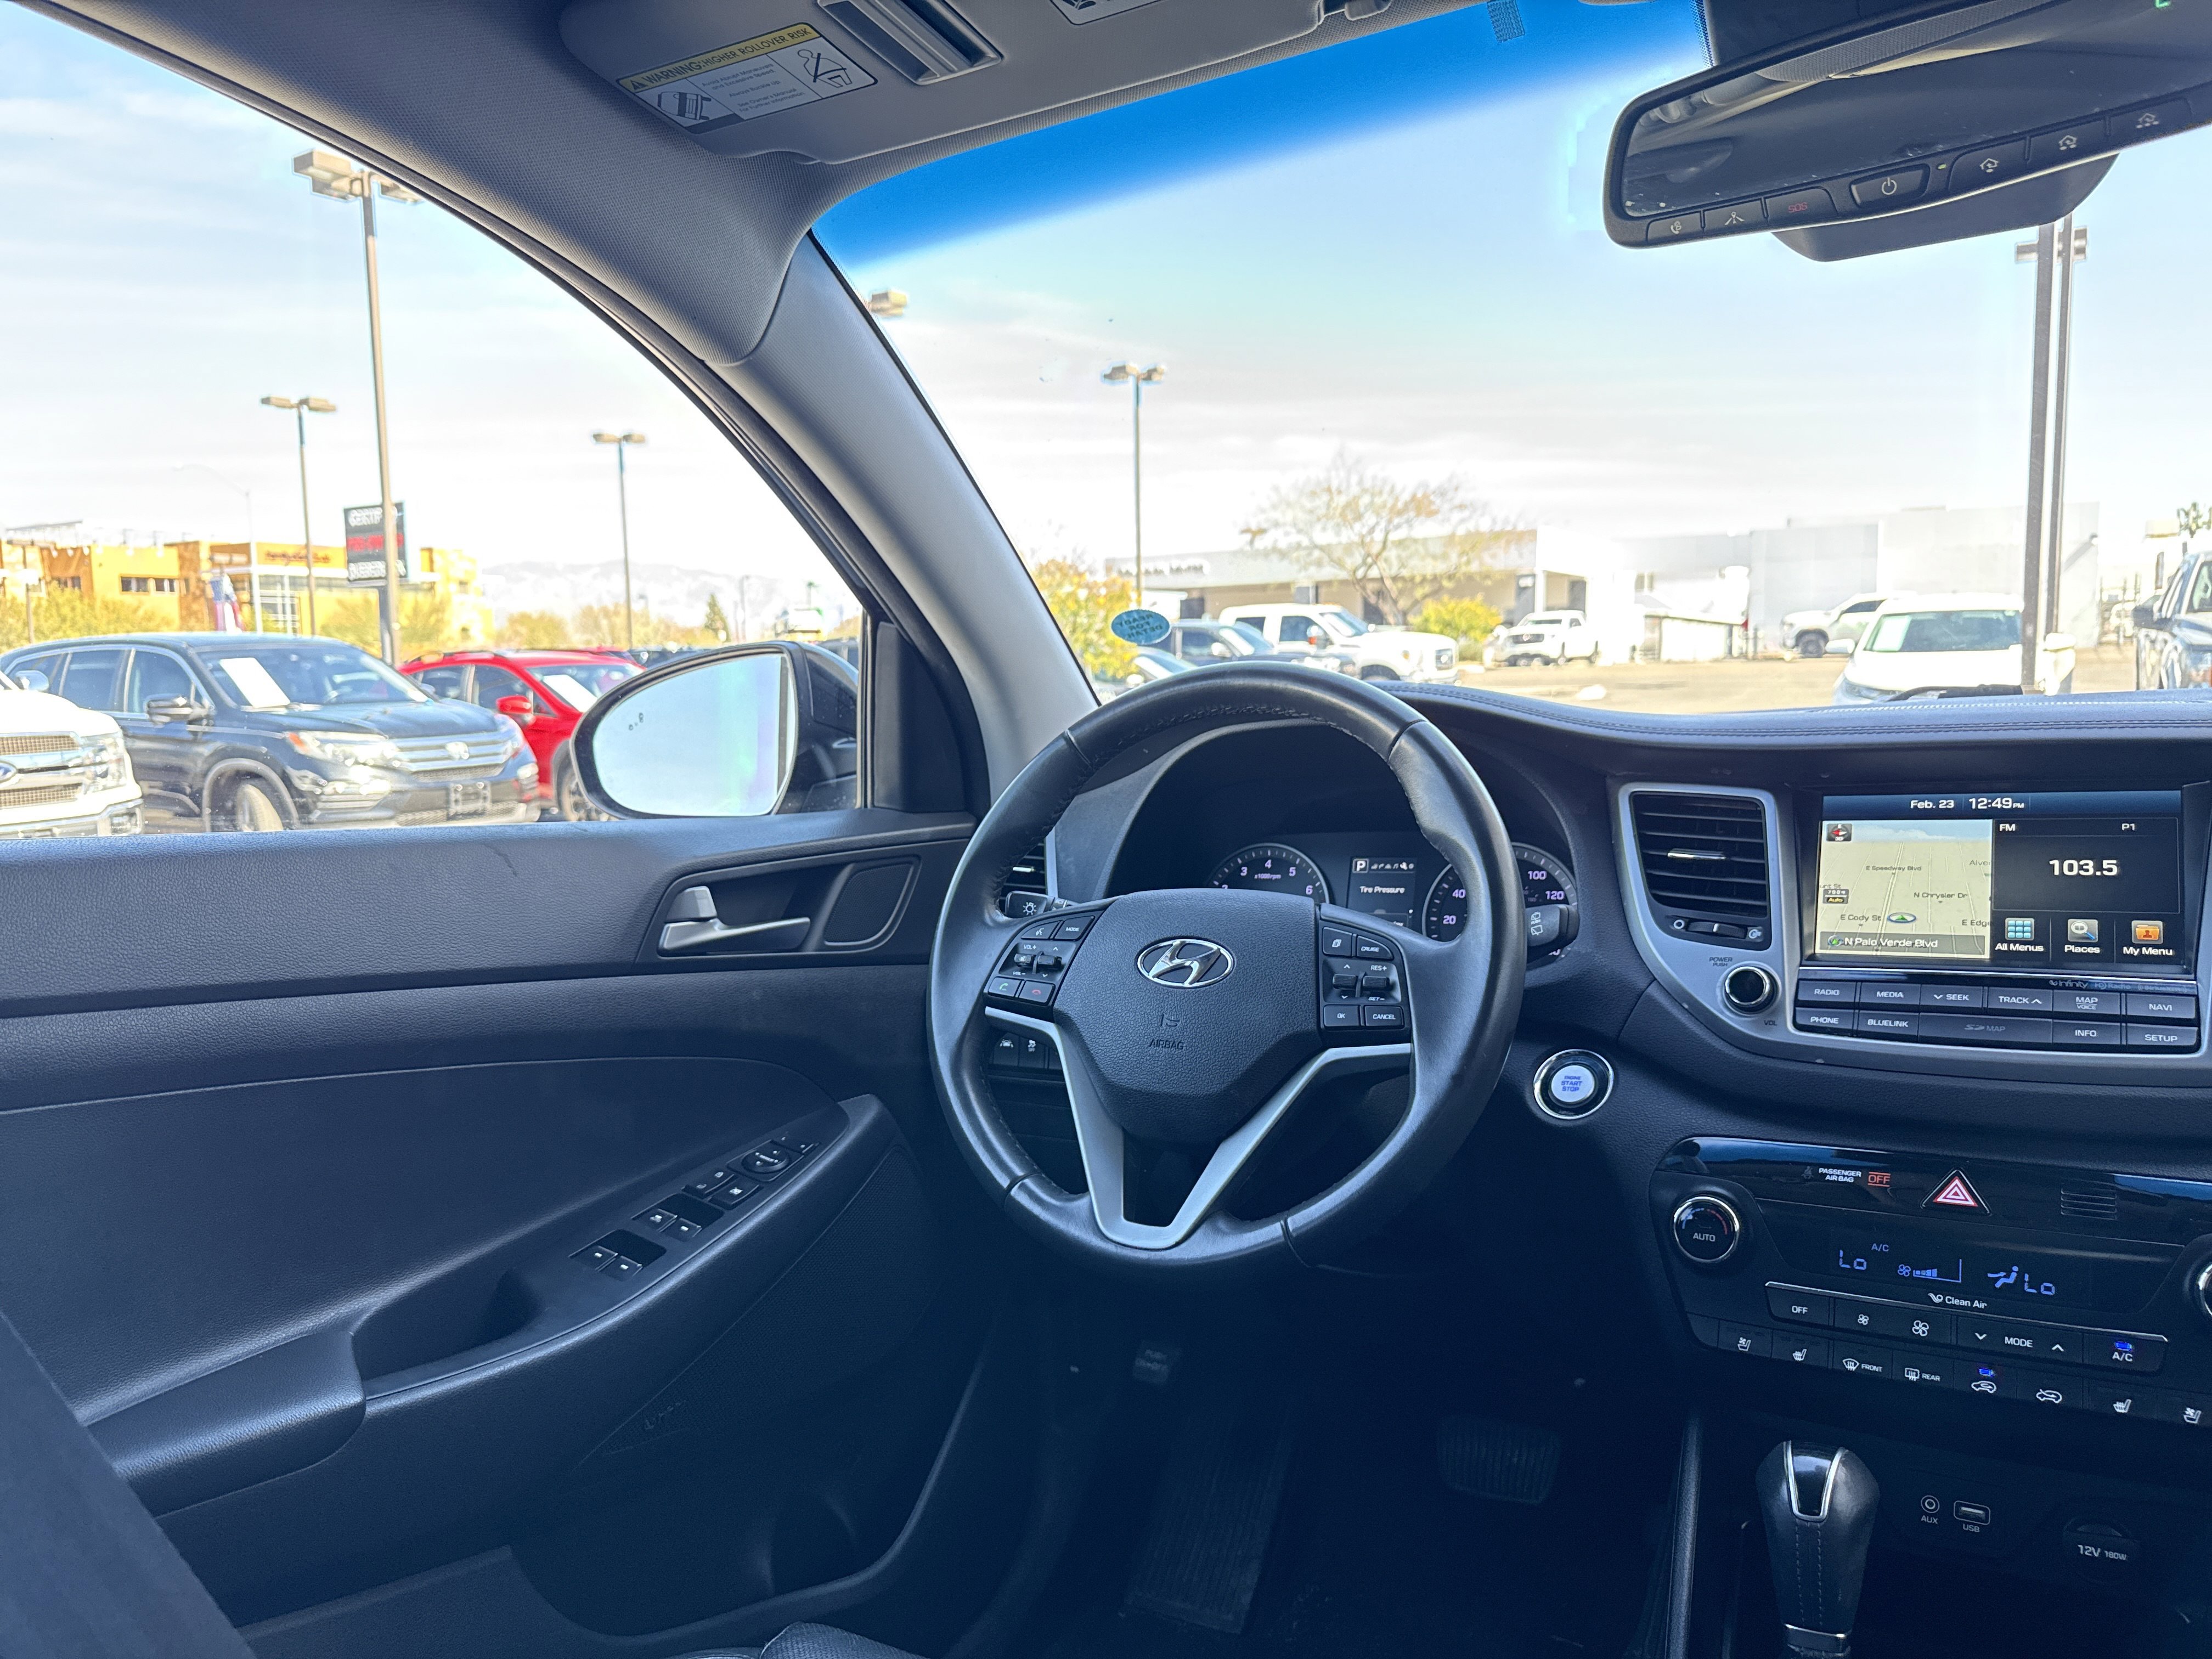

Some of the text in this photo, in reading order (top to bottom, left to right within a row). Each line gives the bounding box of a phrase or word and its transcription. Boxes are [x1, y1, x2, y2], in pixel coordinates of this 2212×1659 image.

[642, 27, 812, 84] WARNING: HIGHER ROLLOVER RISK
[1788, 202, 1808, 213] SOS
[1910, 800, 1936, 809] Feb.
[1939, 799, 1955, 809] 23
[1999, 823, 2016, 832] FM
[2121, 823, 2135, 831] P1
[1265, 859, 1272, 869] 4
[1356, 860, 1366, 872] P
[2049, 859, 2118, 876] 103.5
[1240, 866, 1248, 876] 3
[1289, 867, 1296, 877] 5
[1527, 871, 1547, 880] 100
[1305, 885, 1313, 895] 6
[1359, 885, 1406, 894] Tire Pressure
[1452, 889, 1466, 899] 40
[1545, 890, 1565, 900] 120
[1442, 915, 1457, 924] 20
[1844, 937, 1938, 947] N Palo Verde Blvd
[2009, 943, 2044, 952] Menus
[2064, 945, 2100, 953] Places
[2123, 947, 2173, 956] My Menu
[1998, 996, 2029, 1004] TRACK
[1867, 1019, 1909, 1028] BLUELINK
[2145, 1034, 2178, 1042] SETUP
[1819, 1167, 1861, 1177] PASSENGER
[1868, 1175, 1891, 1184] OFF
[1692, 1232, 1716, 1242] AUTO
[1871, 1243, 1889, 1252] A/C
[1945, 1295, 1988, 1309] Clean Air
[1791, 1305, 1809, 1314] OFF
[2004, 1336, 2033, 1348] MODE
[2112, 1352, 2134, 1362] A/C
[1861, 1363, 1883, 1373] FRONT
[1921, 1373, 1940, 1382] REAR
[1921, 1515, 1938, 1525] AUX
[1962, 1523, 1980, 1533] USB
[2077, 1544, 2129, 1561] 12V 180W
